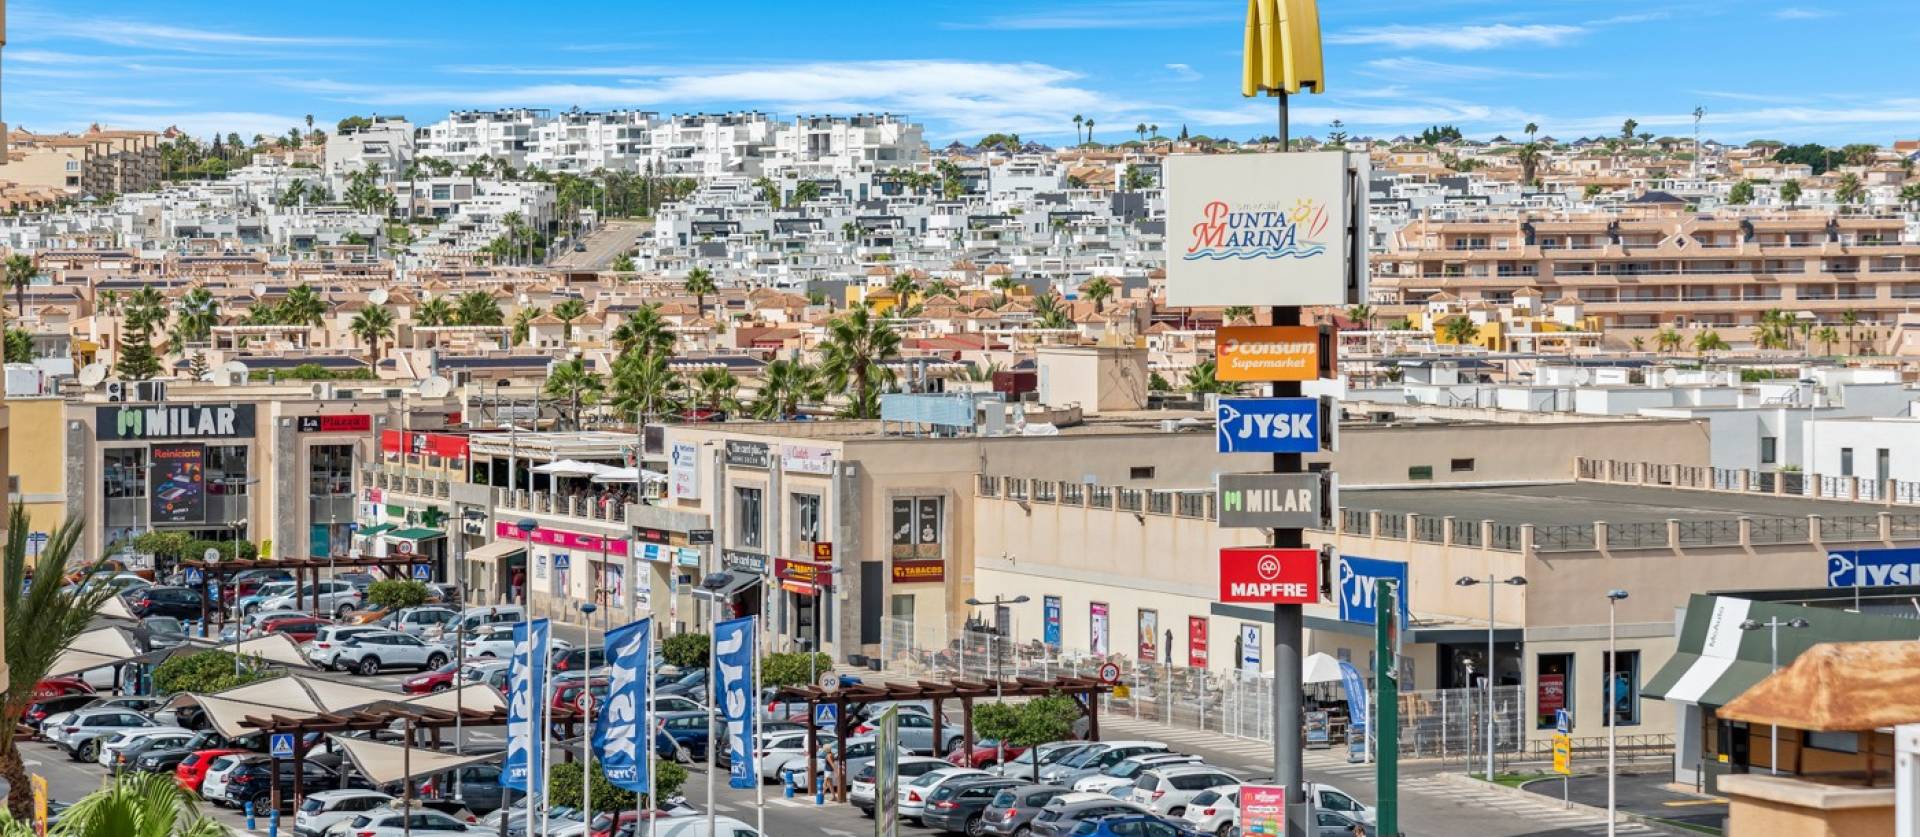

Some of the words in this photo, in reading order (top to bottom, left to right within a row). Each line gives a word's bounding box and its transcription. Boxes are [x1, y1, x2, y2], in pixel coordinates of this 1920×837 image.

[1203, 201, 1287, 229] PUNTA
[1187, 222, 1297, 253] MARINA
[1239, 342, 1317, 355] consum
[1231, 357, 1306, 371] Supermarket
[146, 407, 235, 436] MILAR
[1238, 413, 1313, 438] JYSK
[1246, 490, 1312, 512] MILAR
[1231, 582, 1308, 597] MAPFRE
[824, 679, 835, 687] 20
